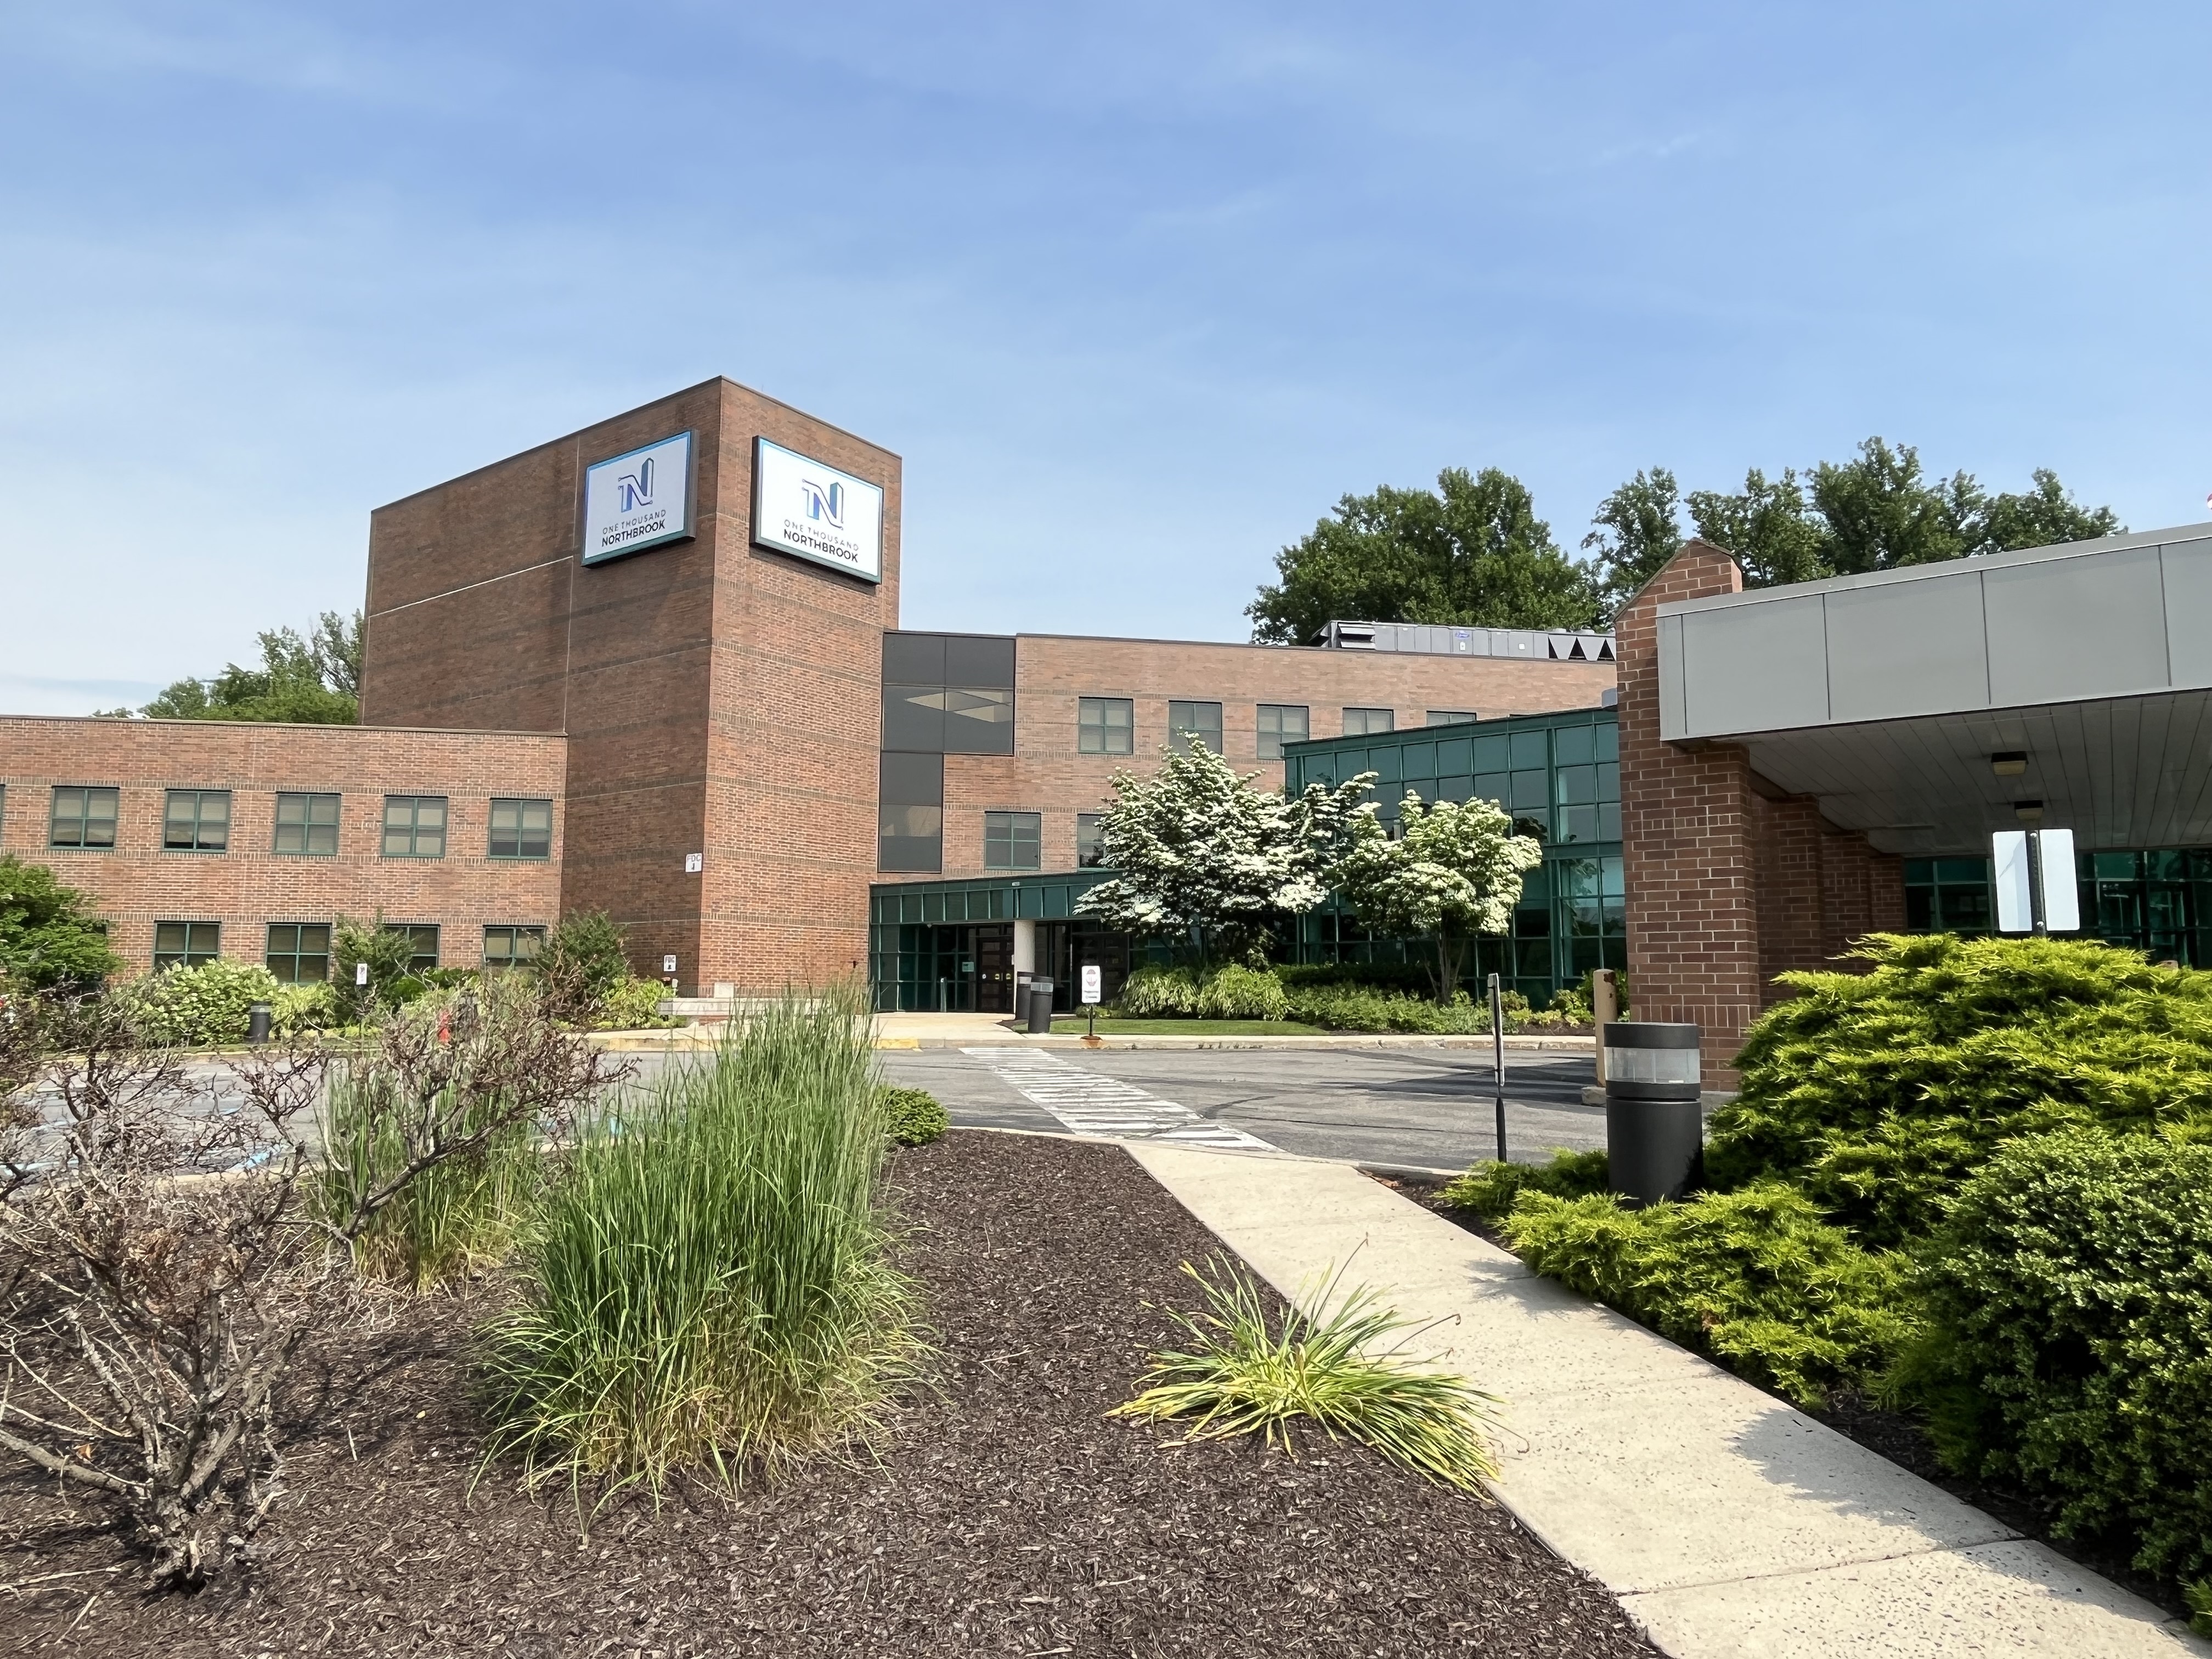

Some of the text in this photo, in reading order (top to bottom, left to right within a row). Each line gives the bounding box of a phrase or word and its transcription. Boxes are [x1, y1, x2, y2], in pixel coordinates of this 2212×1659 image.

[601, 518, 665, 548] NORTHBROOK
[602, 509, 666, 535] ONE THOUSAND
[784, 518, 859, 551] ONE THOUSAND
[783, 528, 858, 563] NORTHBROOK
